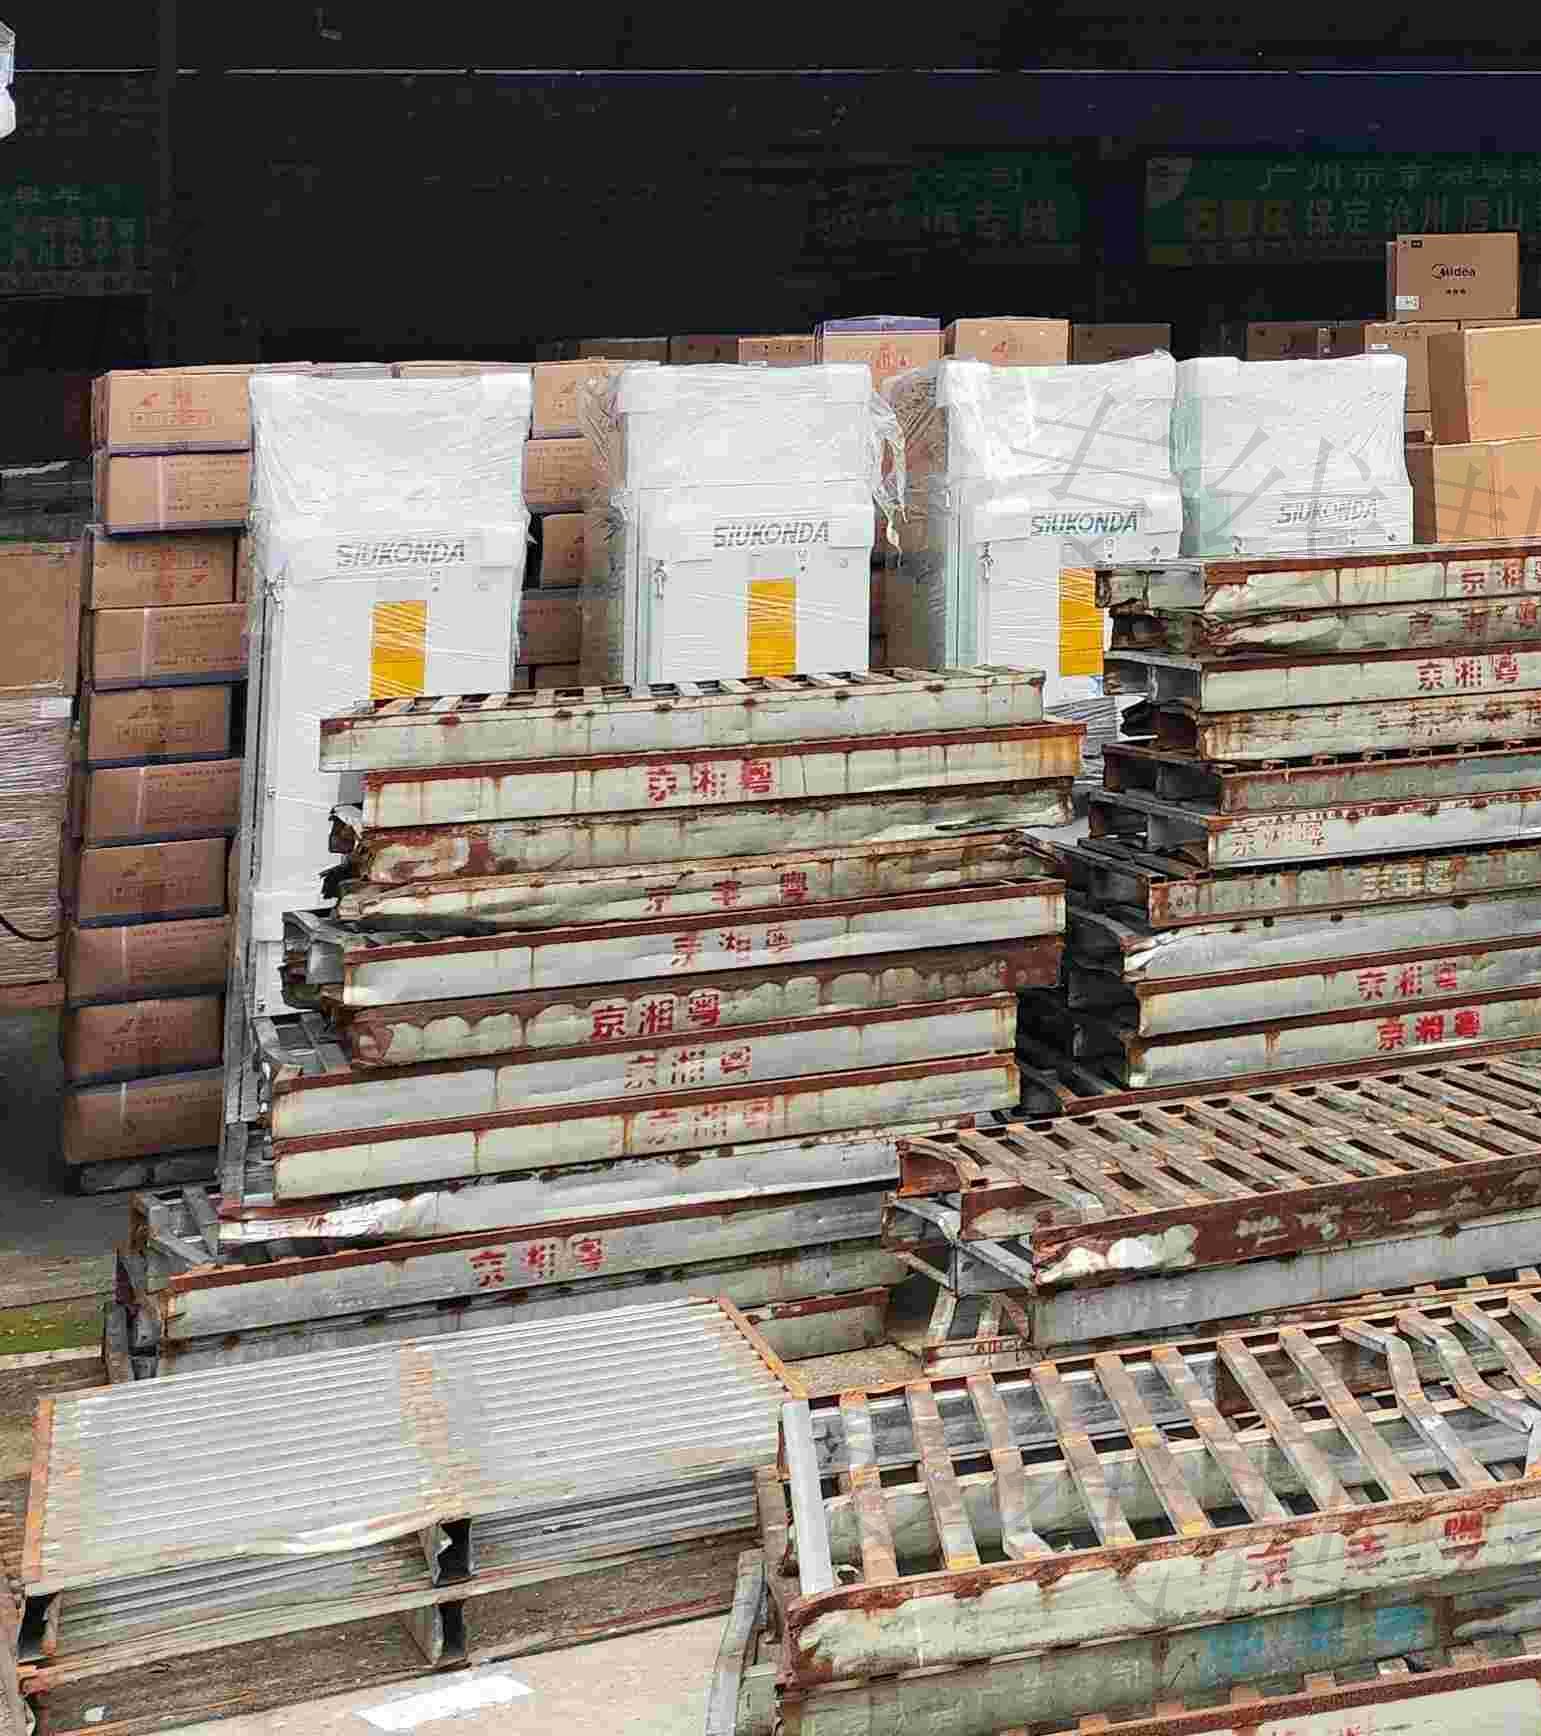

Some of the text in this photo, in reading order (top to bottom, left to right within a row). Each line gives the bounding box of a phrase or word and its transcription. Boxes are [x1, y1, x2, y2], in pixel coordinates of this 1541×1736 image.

[591, 994, 721, 1041] 京湘粤
[1376, 1010, 1481, 1050] 京湘粤
[469, 1236, 606, 1290] 京湘粤
